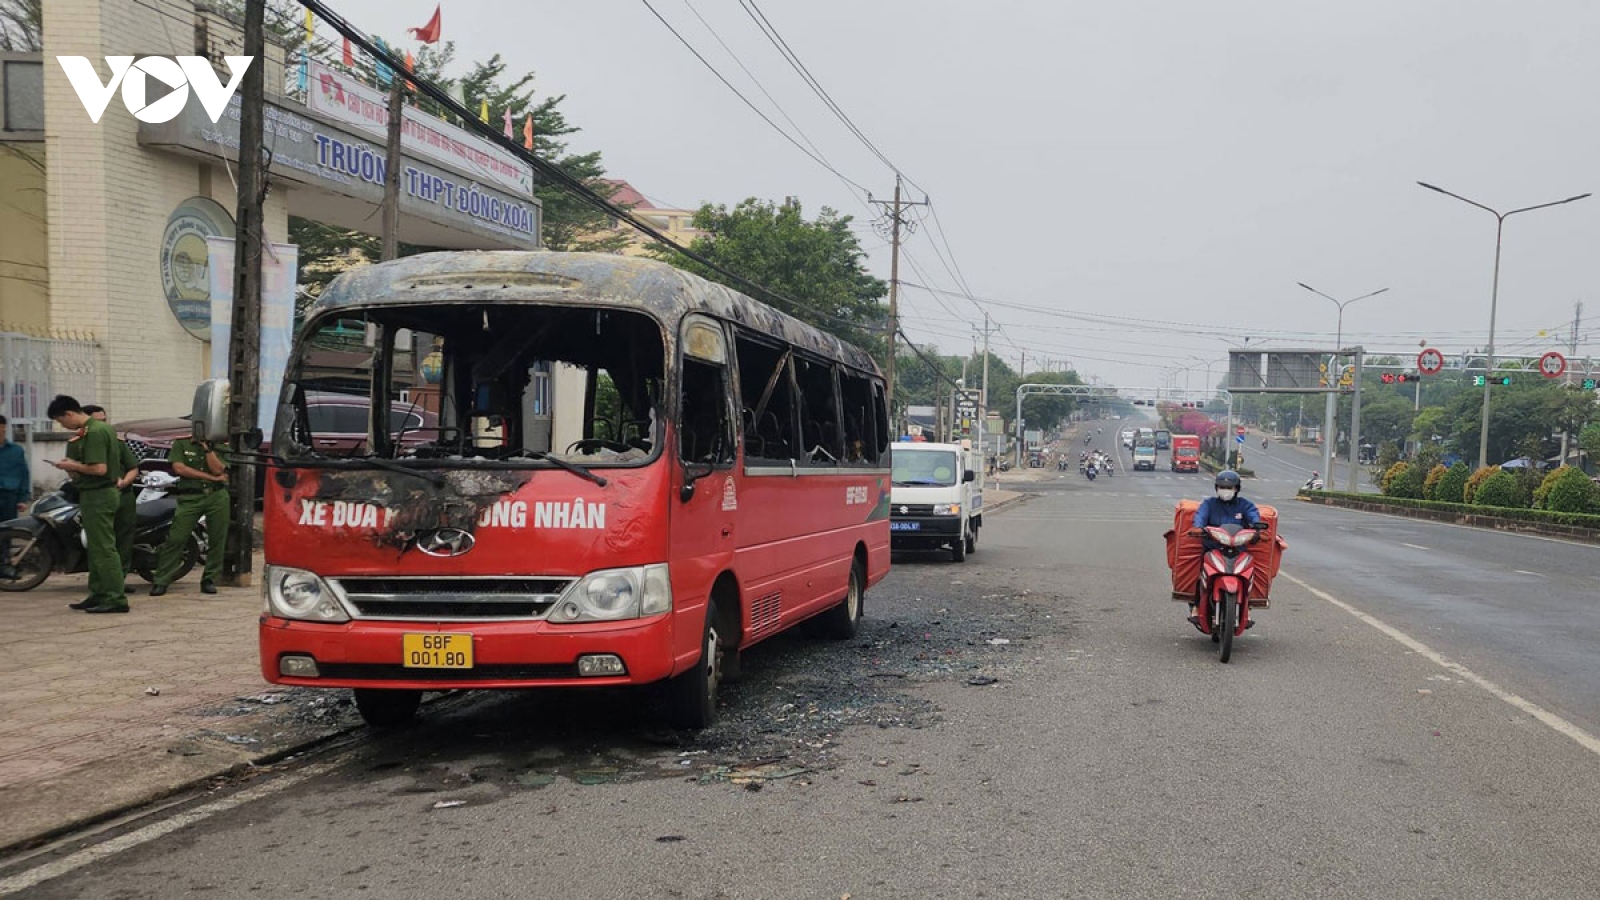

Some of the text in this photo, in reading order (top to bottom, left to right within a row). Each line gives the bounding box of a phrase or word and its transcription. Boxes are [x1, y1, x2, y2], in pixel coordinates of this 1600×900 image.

[315, 133, 402, 187] TRƯỜN
[405, 166, 454, 208] THPT
[456, 182, 500, 222] ĐỒNG
[502, 201, 534, 233] XOÀI
[298, 499, 326, 526] XE
[534, 496, 606, 529] NHÂN
[423, 635, 452, 649] 68F
[411, 650, 465, 666] 001.80
